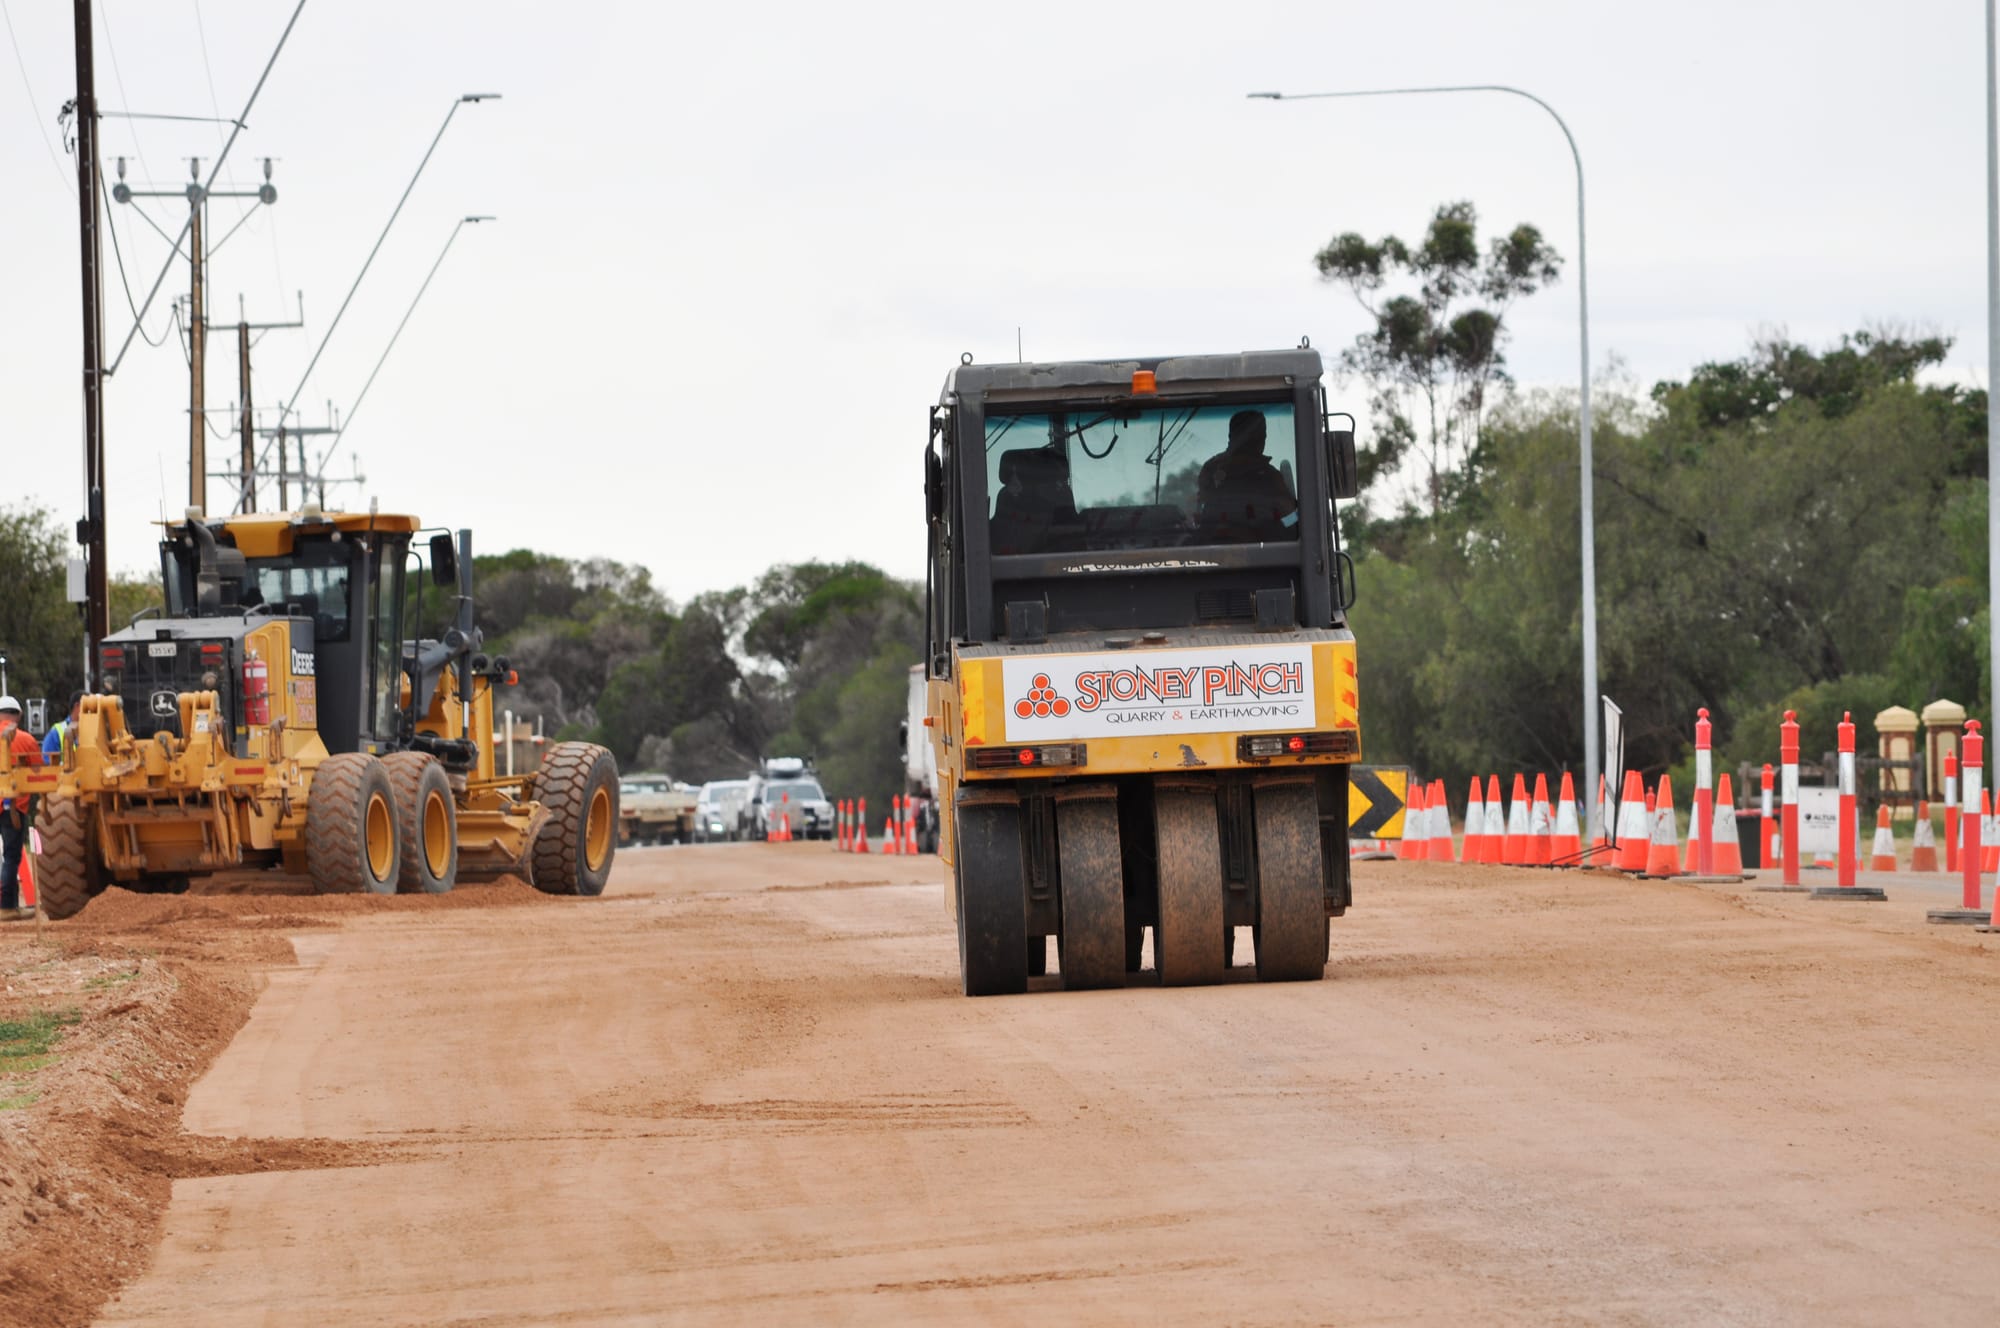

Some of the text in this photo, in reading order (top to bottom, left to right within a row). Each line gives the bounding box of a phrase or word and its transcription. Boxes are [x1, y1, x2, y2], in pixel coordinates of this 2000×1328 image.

[291, 647, 315, 675] DEERE
[1075, 660, 1303, 712] STONEY PINCH
[1106, 705, 1299, 723] QUARRY & EARTHMOVING
